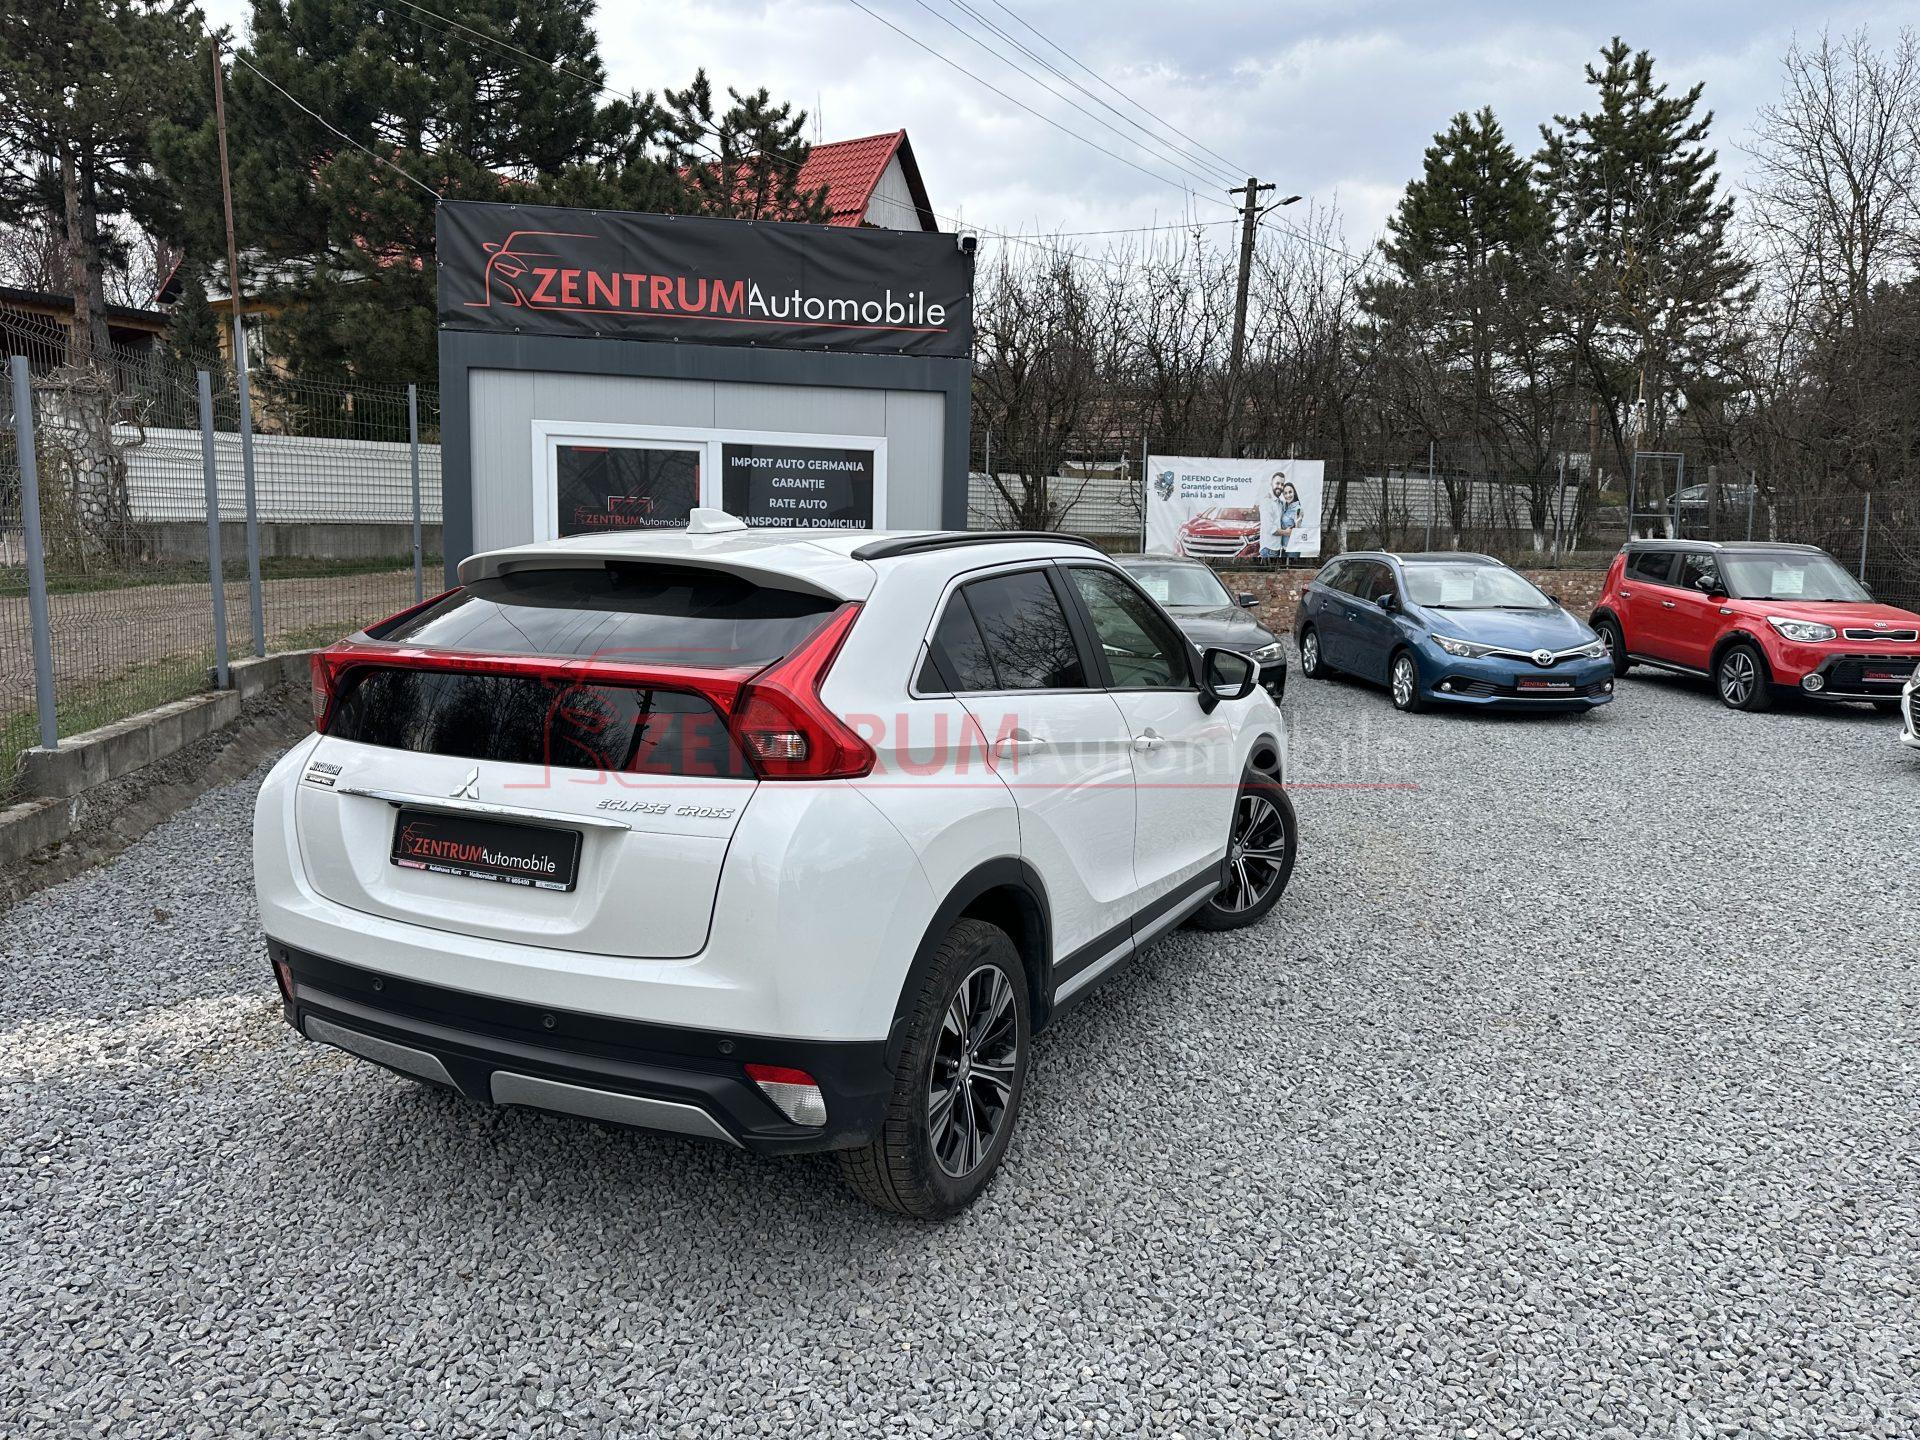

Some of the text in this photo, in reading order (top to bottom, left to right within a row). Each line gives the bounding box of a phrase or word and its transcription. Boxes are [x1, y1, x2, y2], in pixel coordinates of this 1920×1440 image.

[731, 457, 865, 472] IMPORT AUTO GERMANIA
[772, 477, 825, 491] GARANȚIE
[1181, 474, 1211, 482] DEFEND
[1225, 476, 1252, 484] Protect
[1181, 483, 1211, 491] Garanție
[769, 498, 828, 510] RATE AUTO
[586, 514, 690, 527] ZENTRUM Automobile
[736, 516, 866, 529] RANSPORT LA DOMICILIU
[595, 799, 735, 819] ECLIPSE CROSS
[413, 836, 556, 873] ZENTRUM Automobile
